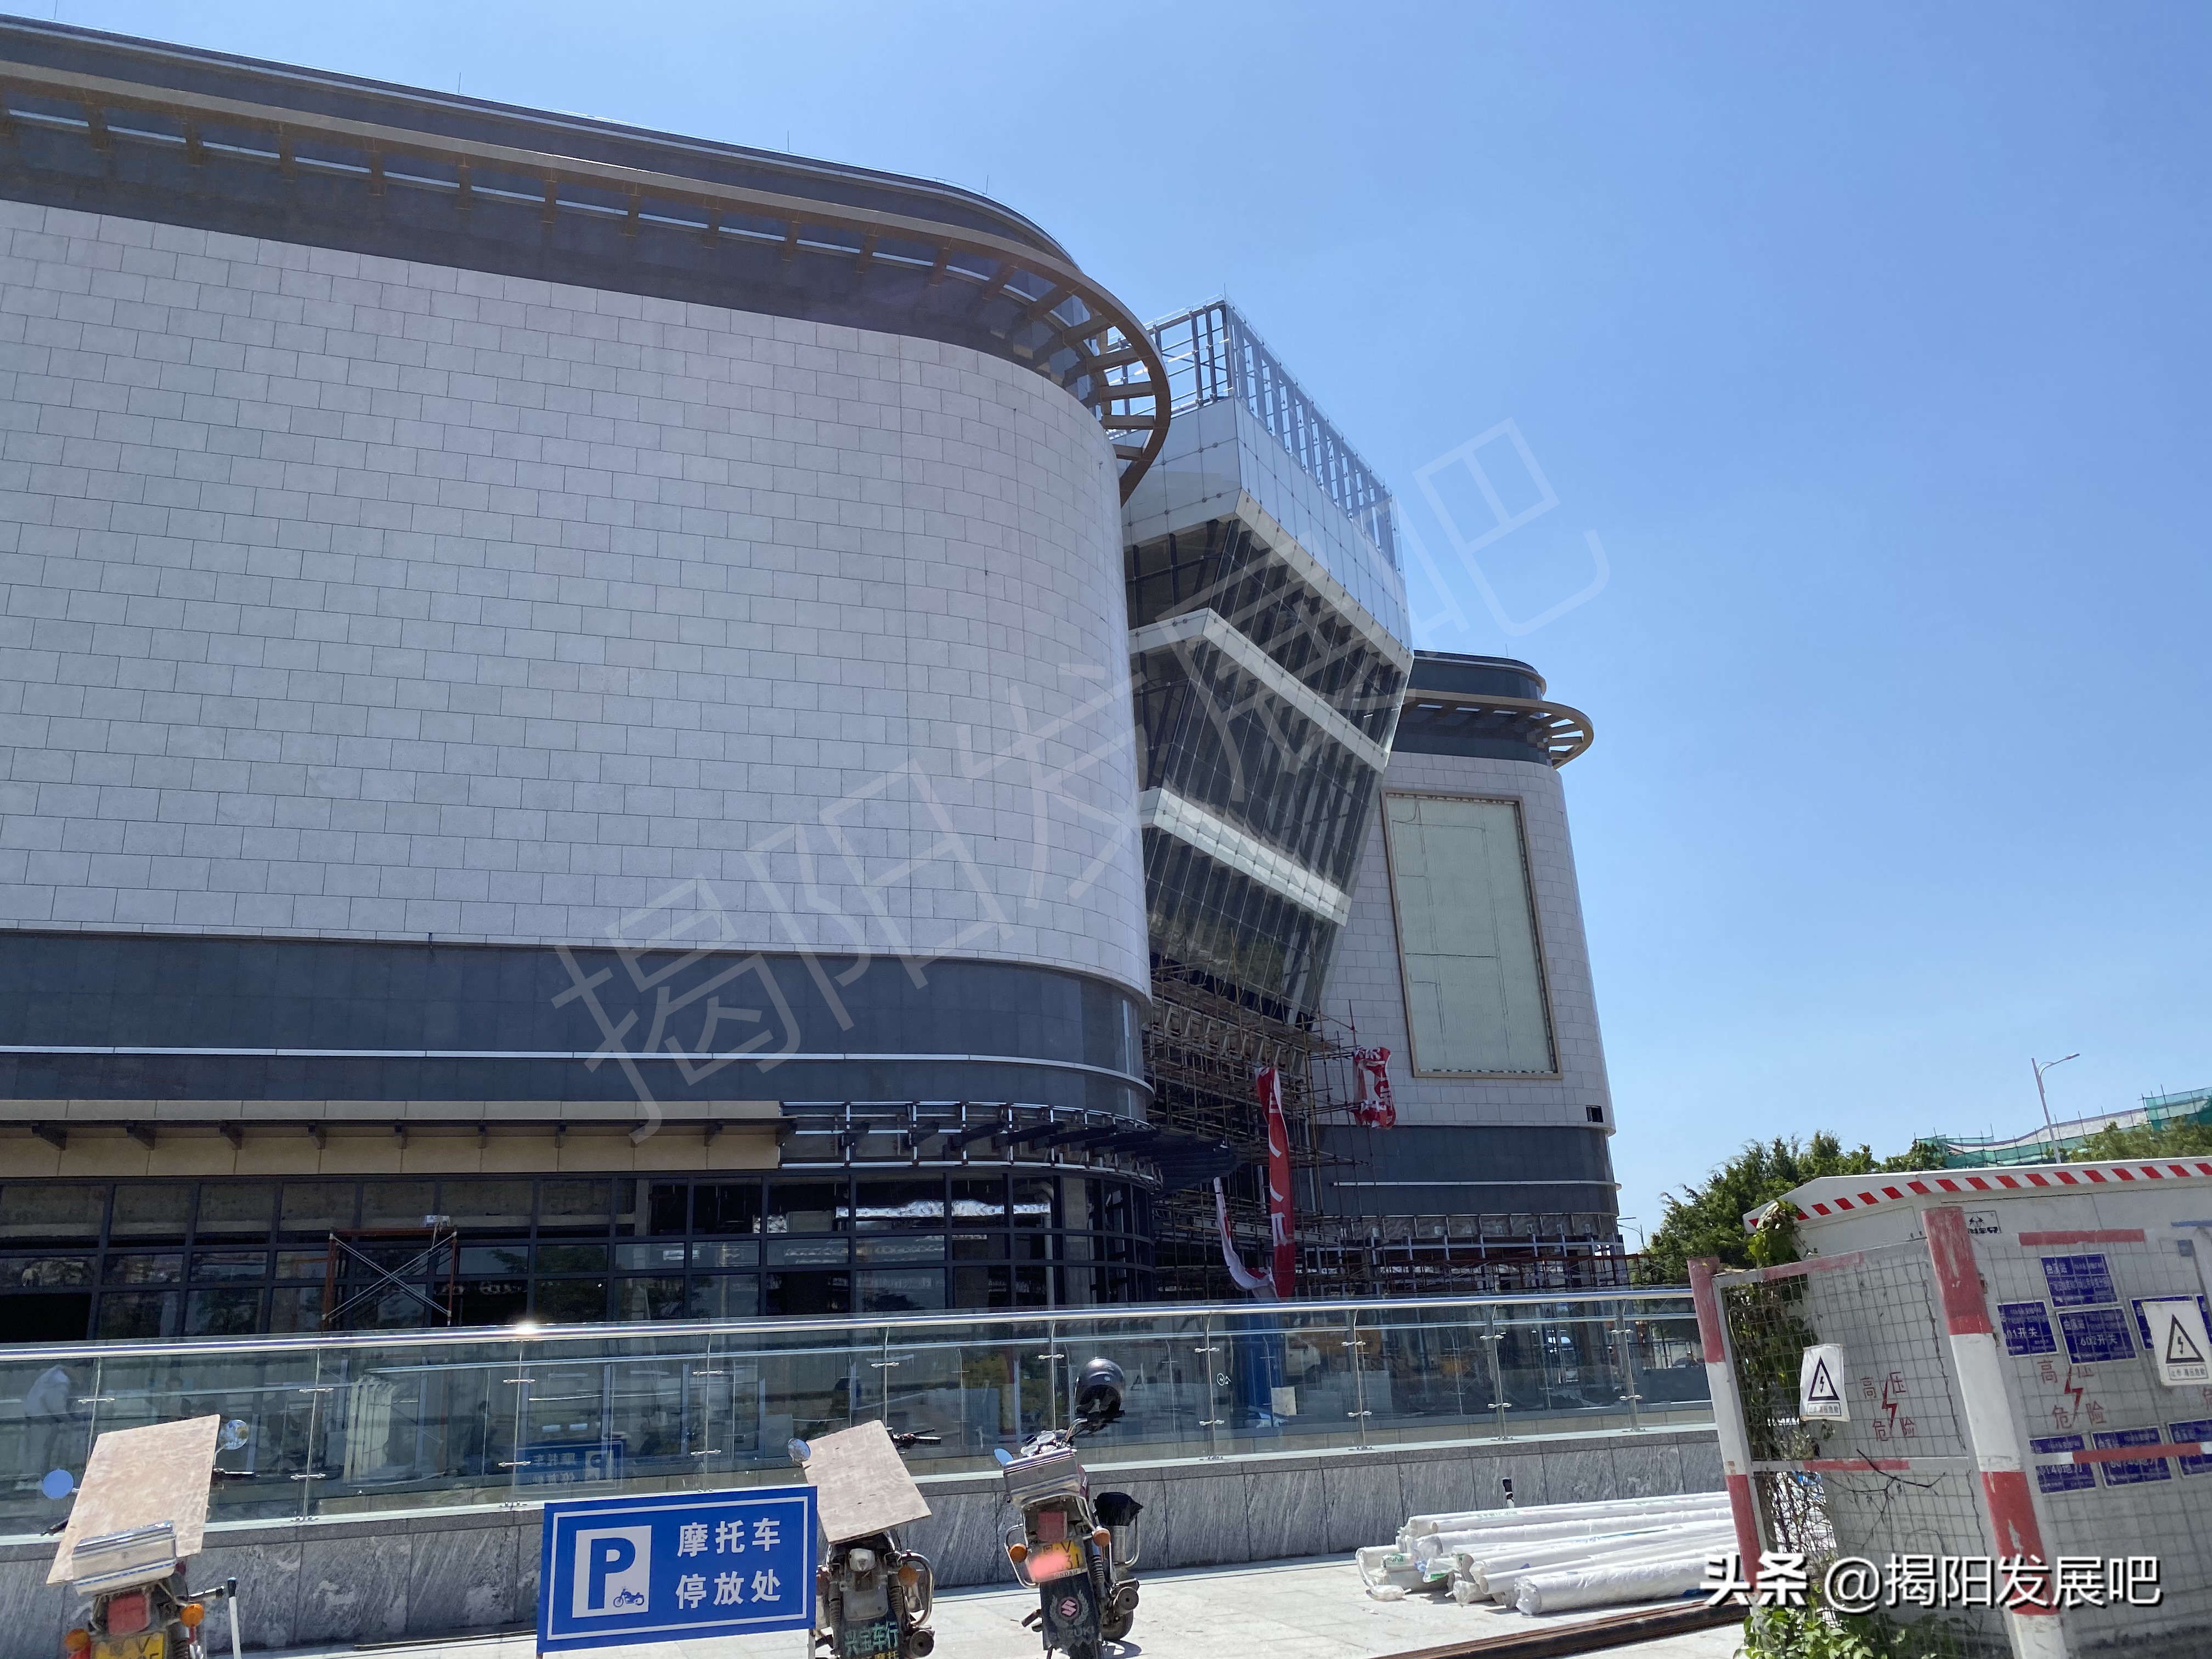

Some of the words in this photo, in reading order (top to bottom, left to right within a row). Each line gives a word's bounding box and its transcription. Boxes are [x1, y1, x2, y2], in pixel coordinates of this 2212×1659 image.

[2005, 1327, 2038, 1339] 01开关
[1860, 1372, 1906, 1398] 高压
[1872, 1416, 1915, 1442] 危险
[2052, 1400, 2107, 1430] 危险
[677, 1517, 781, 1558] 摩托车
[588, 1538, 636, 1610] P
[676, 1568, 781, 1610] 停放处
